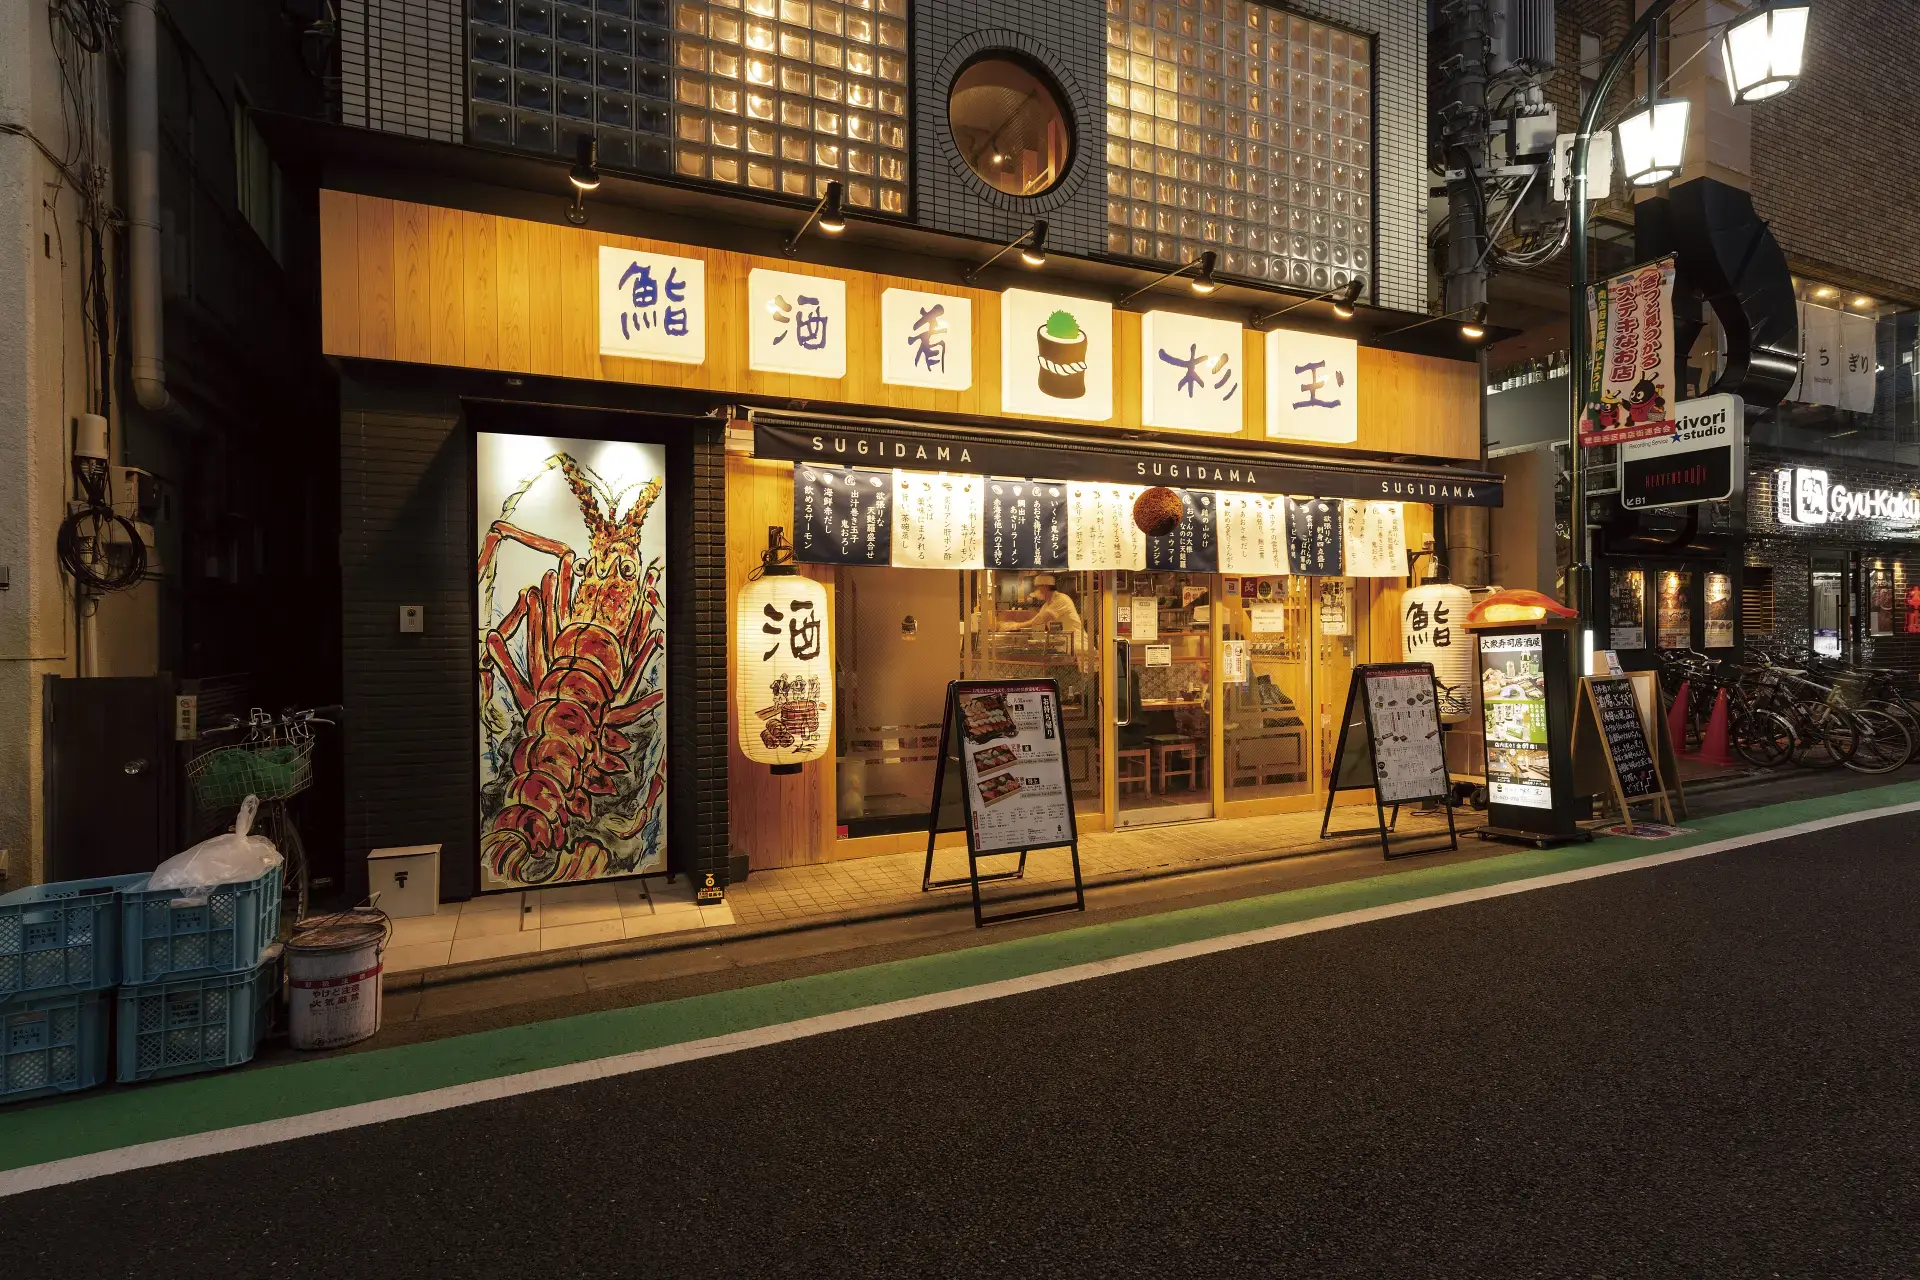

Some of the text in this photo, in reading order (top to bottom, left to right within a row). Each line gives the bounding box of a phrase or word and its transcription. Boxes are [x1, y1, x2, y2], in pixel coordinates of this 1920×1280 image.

[618, 261, 1345, 411] 鮨 酒 肴 杉 玉
[1610, 283, 1639, 382] ステキなお店
[812, 436, 973, 463] SUGIDAMA
[1628, 438, 1668, 449] Recording Service
[1683, 425, 1726, 441] studio
[1137, 462, 1258, 484] SUGIDAMA
[1381, 480, 1476, 498] SUGIDAMA
[804, 485, 814, 549] 飲めるサーモン
[823, 487, 833, 534] 海鮮赤だし
[850, 489, 859, 543] 出汁巻き玉子
[875, 491, 885, 527] 欲張りな
[1635, 496, 1646, 505] B1
[1831, 484, 1920, 521] Gyu-Kaku
[840, 519, 850, 555] 鬼おろし
[1010, 505, 1018, 565] あさりラーメン
[1050, 500, 1059, 559] いくら鬼おろし
[1323, 515, 1332, 544] 欲張りな
[762, 599, 821, 662] 酒
[1406, 600, 1452, 653] 鮨
[1482, 637, 1541, 650] 大衆寿司居酒屋
[1043, 697, 1053, 737] お持ち帰り
[312, 983, 360, 998] やけど注意
[312, 993, 360, 1008] 火気厳禁
